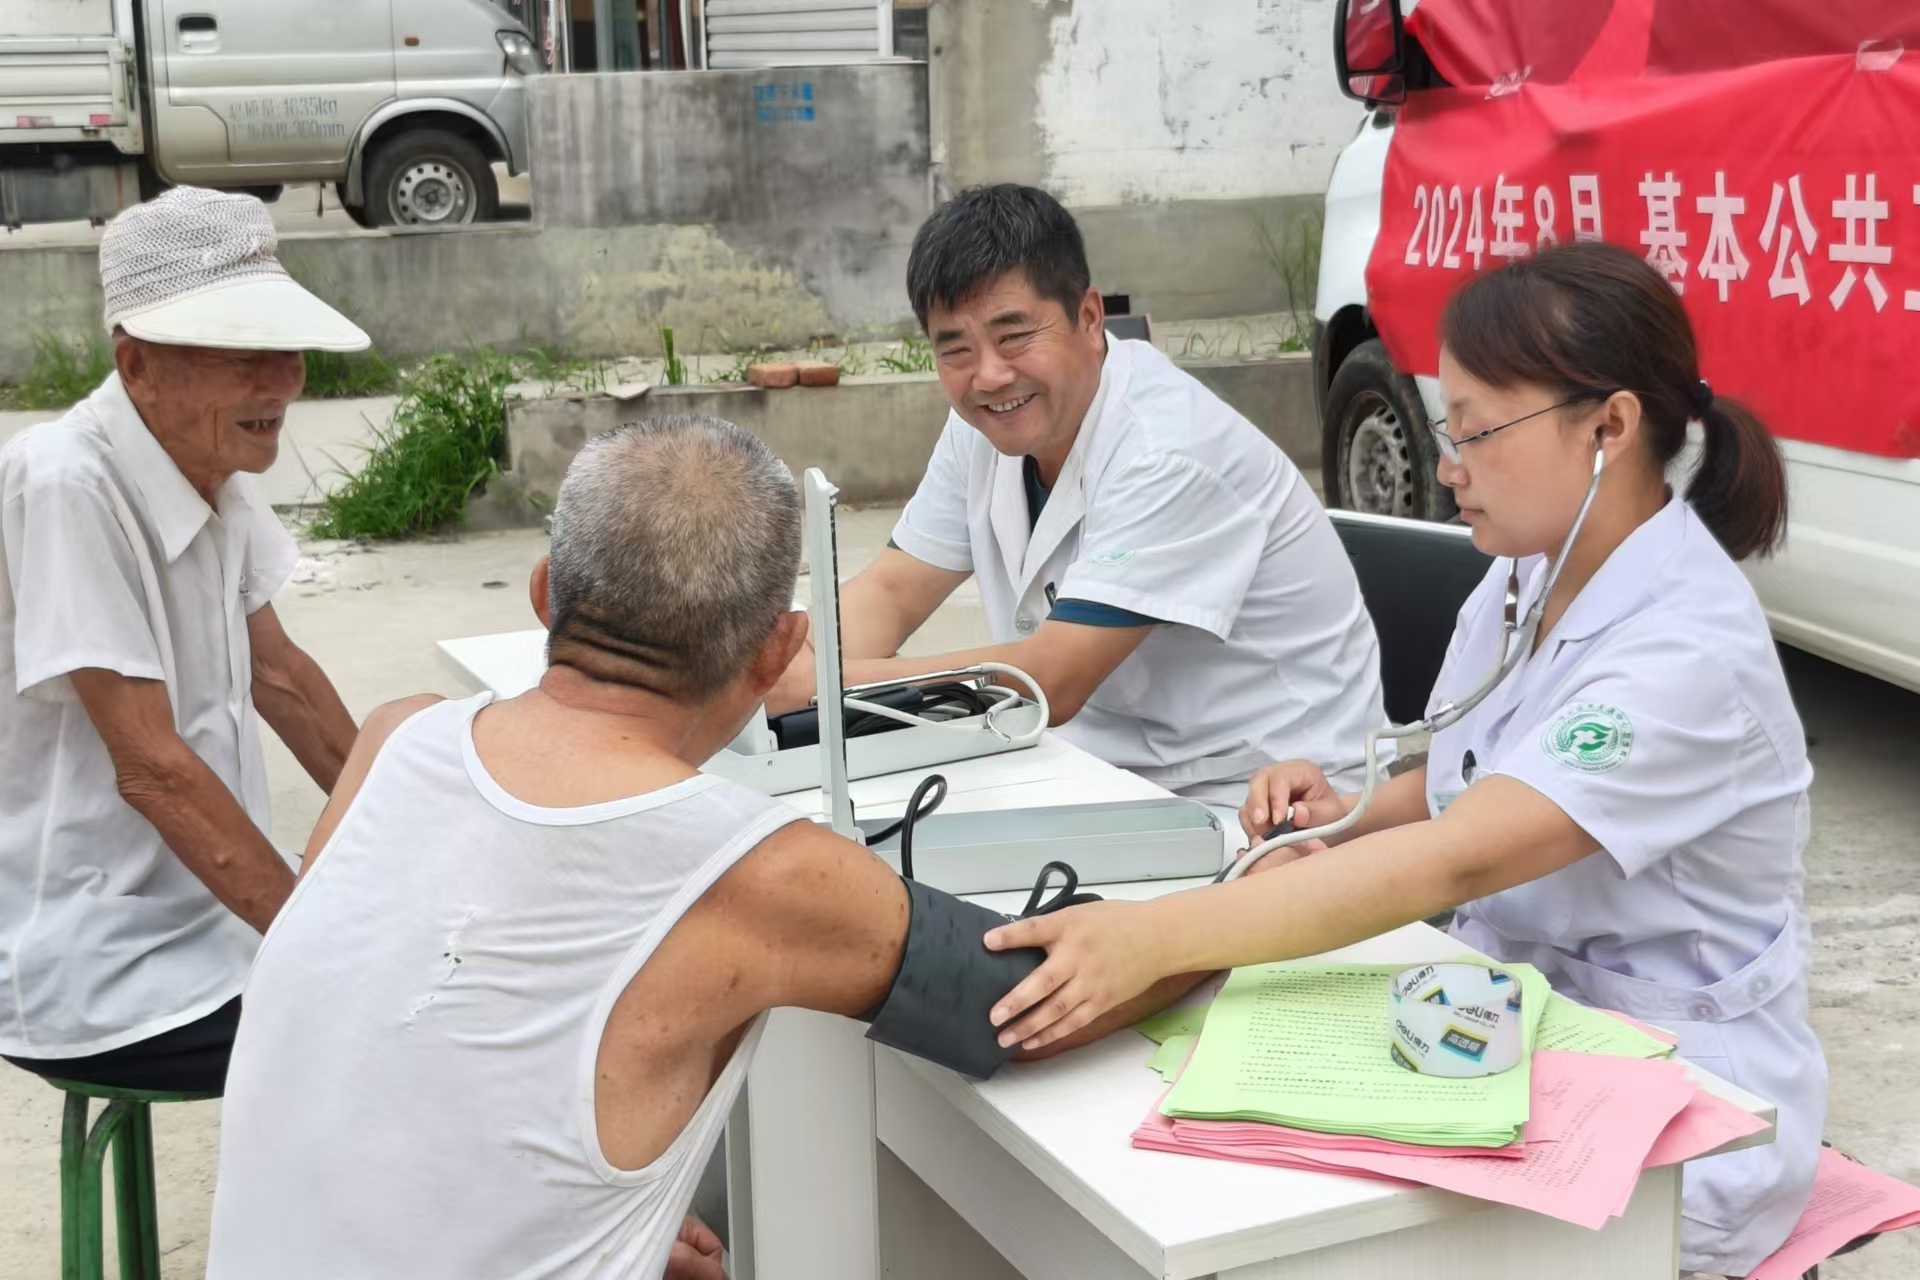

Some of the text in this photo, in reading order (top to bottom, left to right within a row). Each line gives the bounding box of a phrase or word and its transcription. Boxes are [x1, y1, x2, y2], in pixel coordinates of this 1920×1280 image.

[1404, 171, 1920, 313] 2024年8月 基本公共
